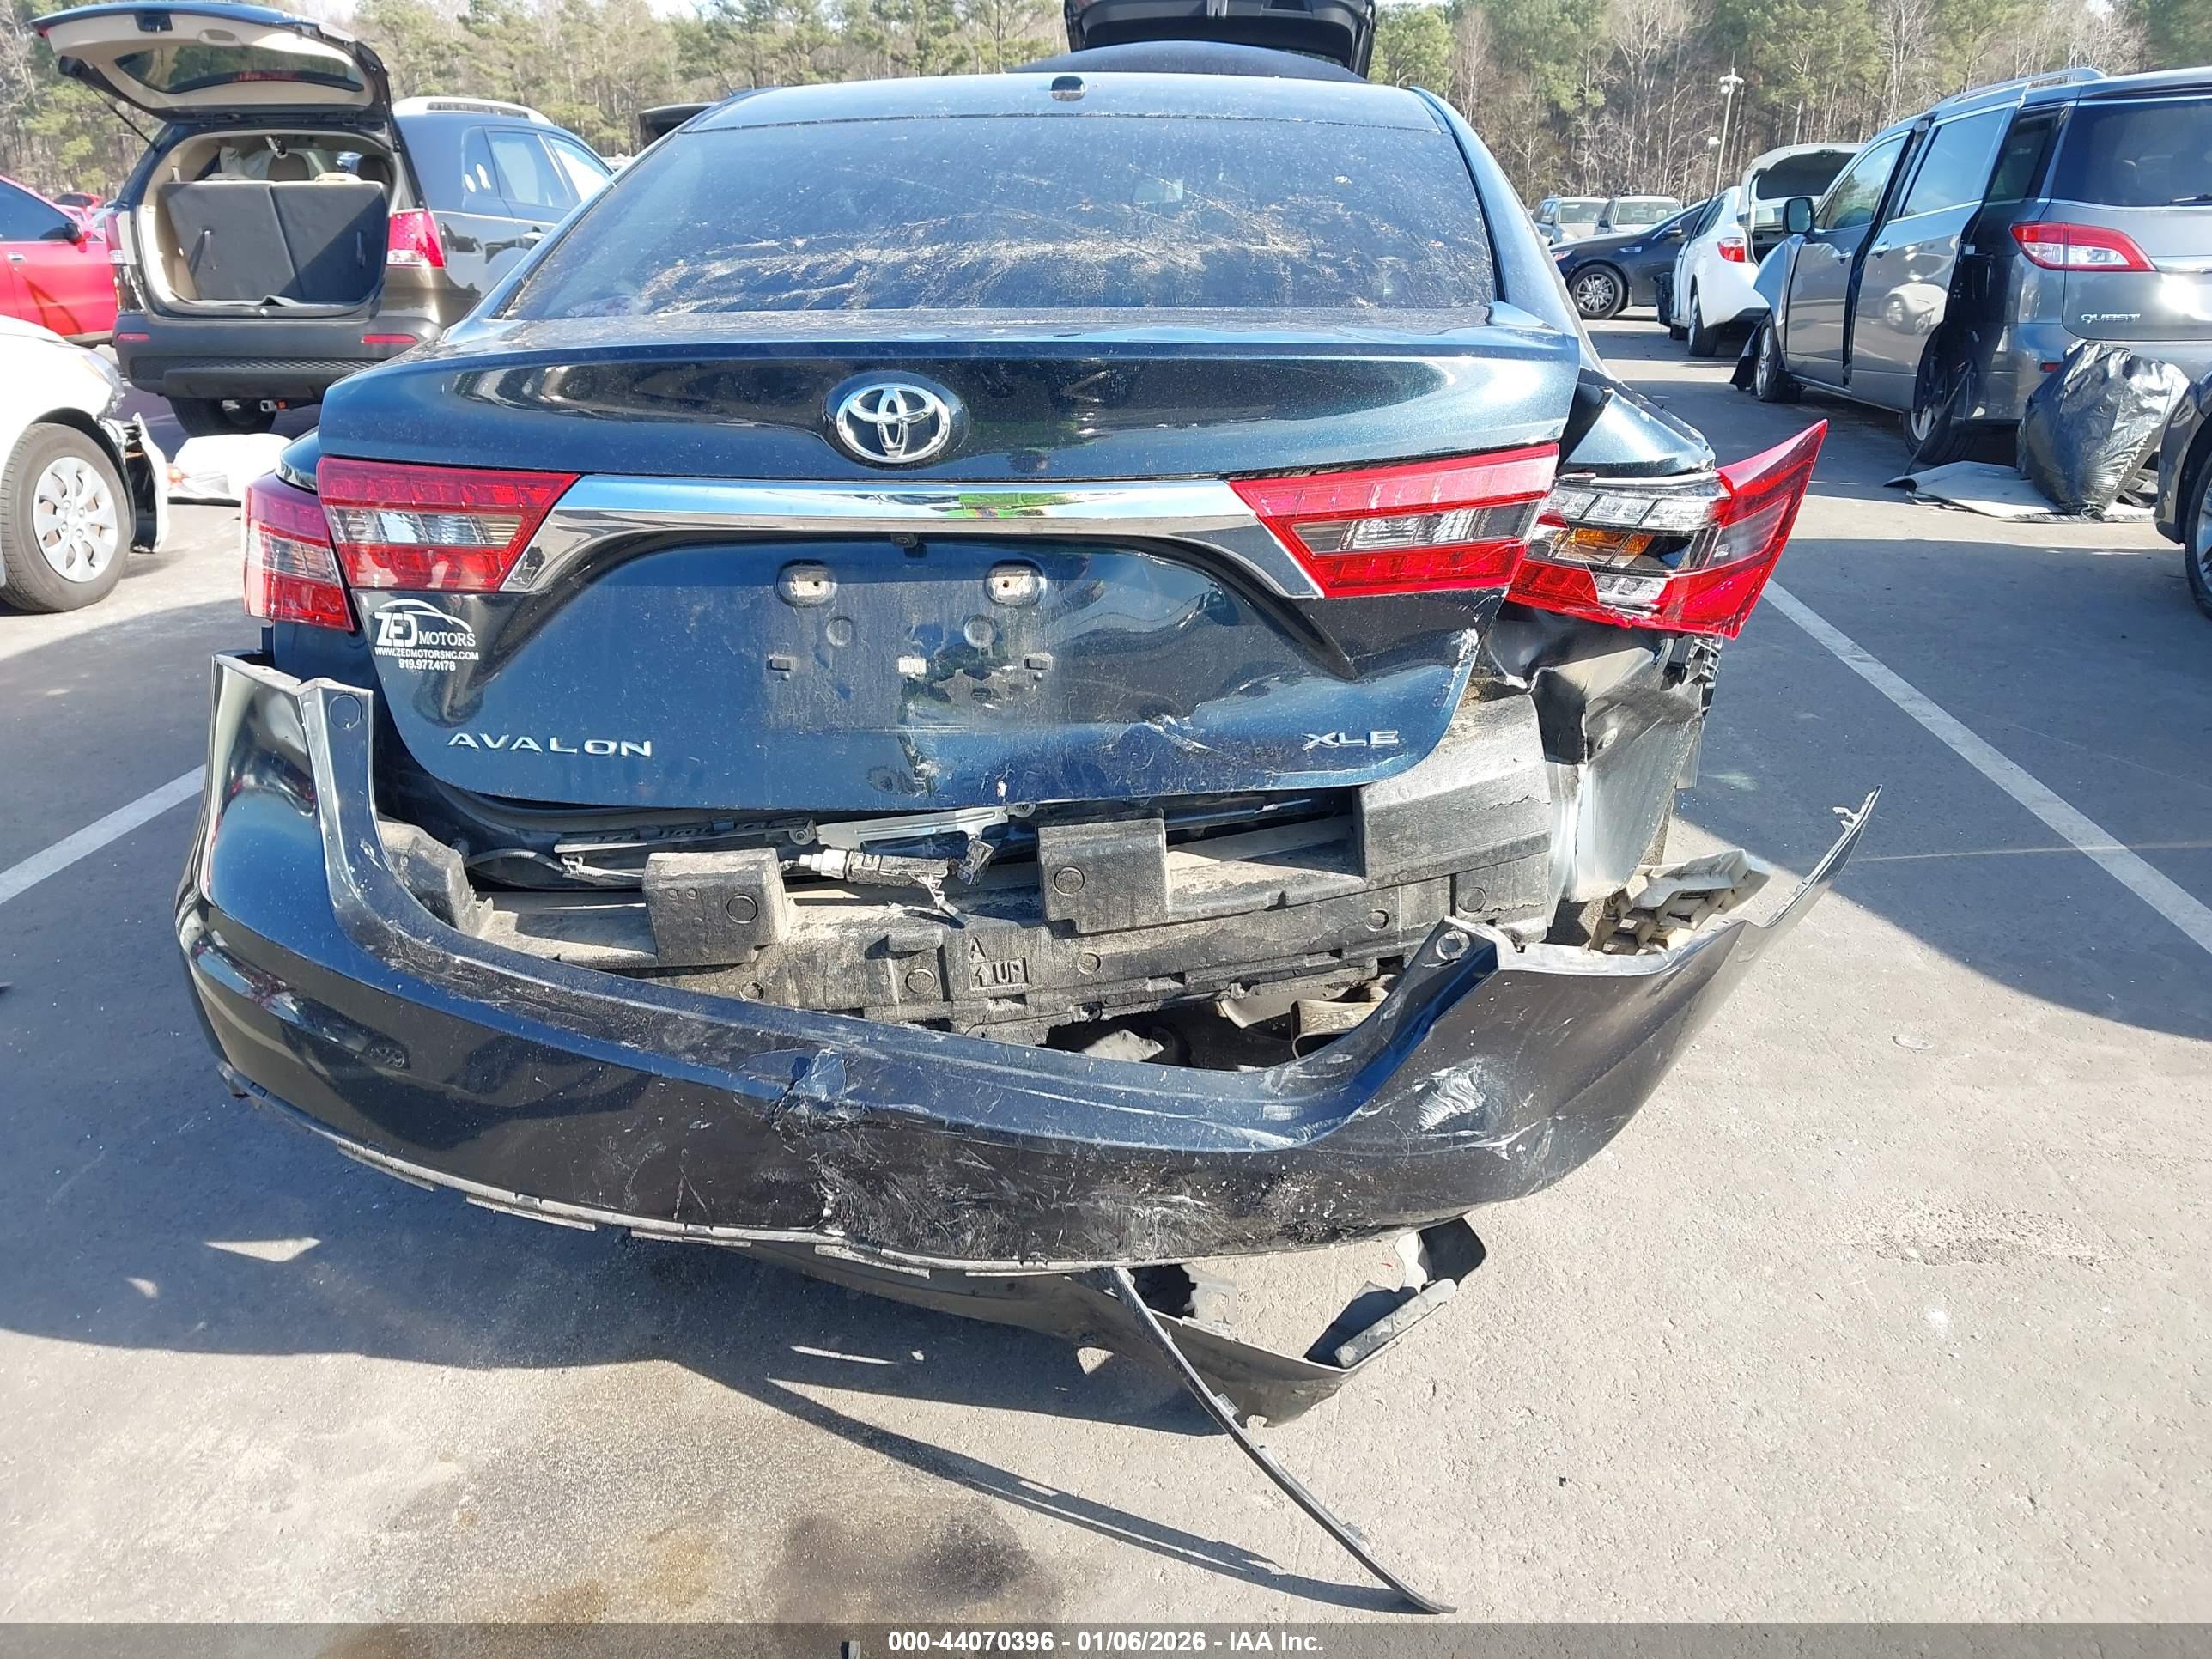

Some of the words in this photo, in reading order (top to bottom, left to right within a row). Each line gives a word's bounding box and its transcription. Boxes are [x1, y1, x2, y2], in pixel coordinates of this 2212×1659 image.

[374, 611, 418, 648] ZED
[418, 630, 477, 647] MOTORS
[374, 647, 480, 661] WWW.ZEDMOTORSNC.COM
[447, 732, 653, 757] AVALON
[1301, 730, 1400, 751] XLE
[968, 935, 988, 962] A
[993, 961, 1022, 984] UP
